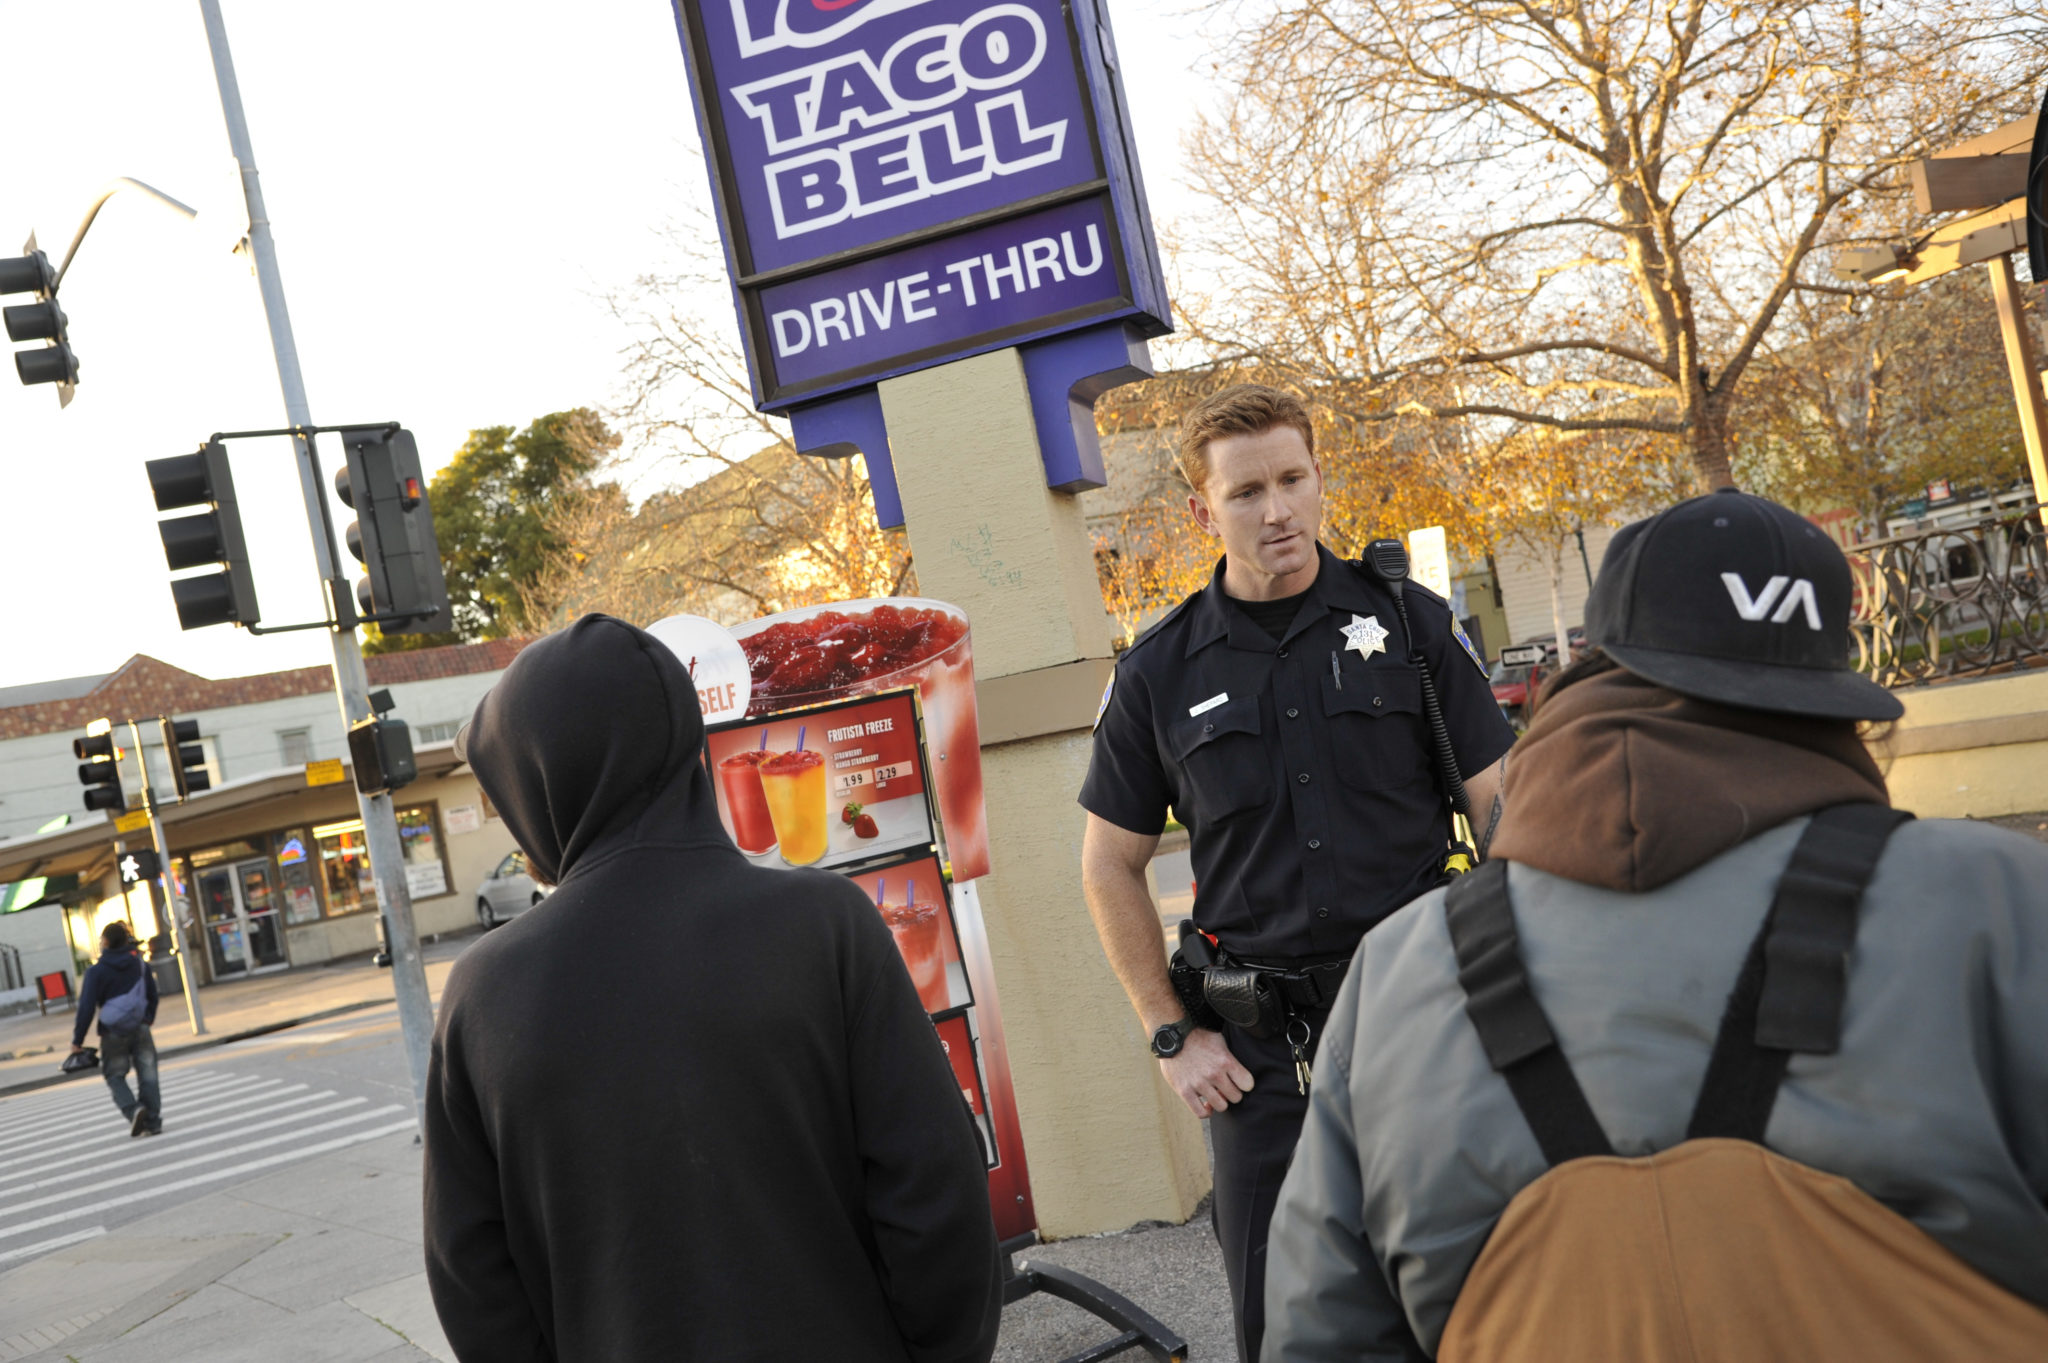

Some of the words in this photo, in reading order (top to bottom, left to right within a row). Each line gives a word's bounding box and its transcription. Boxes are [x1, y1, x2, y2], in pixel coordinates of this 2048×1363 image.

[730, 3, 1047, 156] TACO
[763, 89, 1069, 240] BELL
[771, 223, 1104, 359] DRIVE-THRU
[1346, 623, 1367, 635] SANTA
[1369, 624, 1385, 636] CRUZ
[1350, 634, 1382, 645] POLICE
[1359, 630, 1374, 638] 131
[827, 724, 864, 743] FRUTISTA
[865, 718, 894, 736] FREEZE
